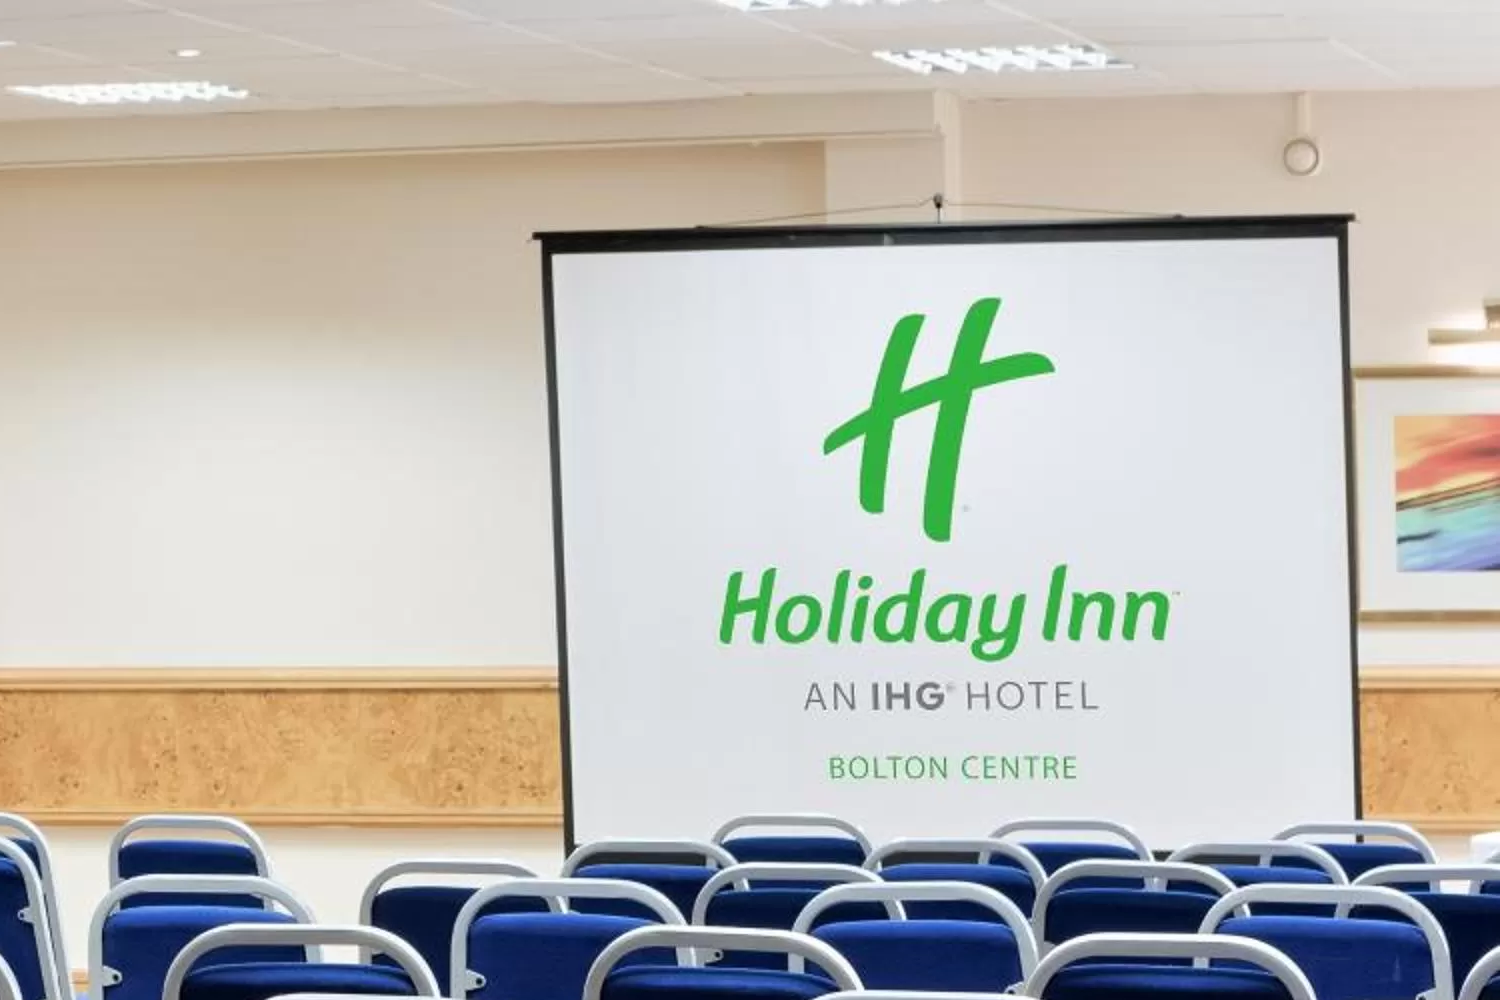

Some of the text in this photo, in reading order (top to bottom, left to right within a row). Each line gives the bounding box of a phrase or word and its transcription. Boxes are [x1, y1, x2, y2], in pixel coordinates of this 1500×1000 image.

[718, 563, 1172, 664] Holiday Inn
[803, 681, 857, 712] AN
[966, 680, 1100, 711] HOTEL
[829, 755, 1077, 780] BOLTON CENTRE
